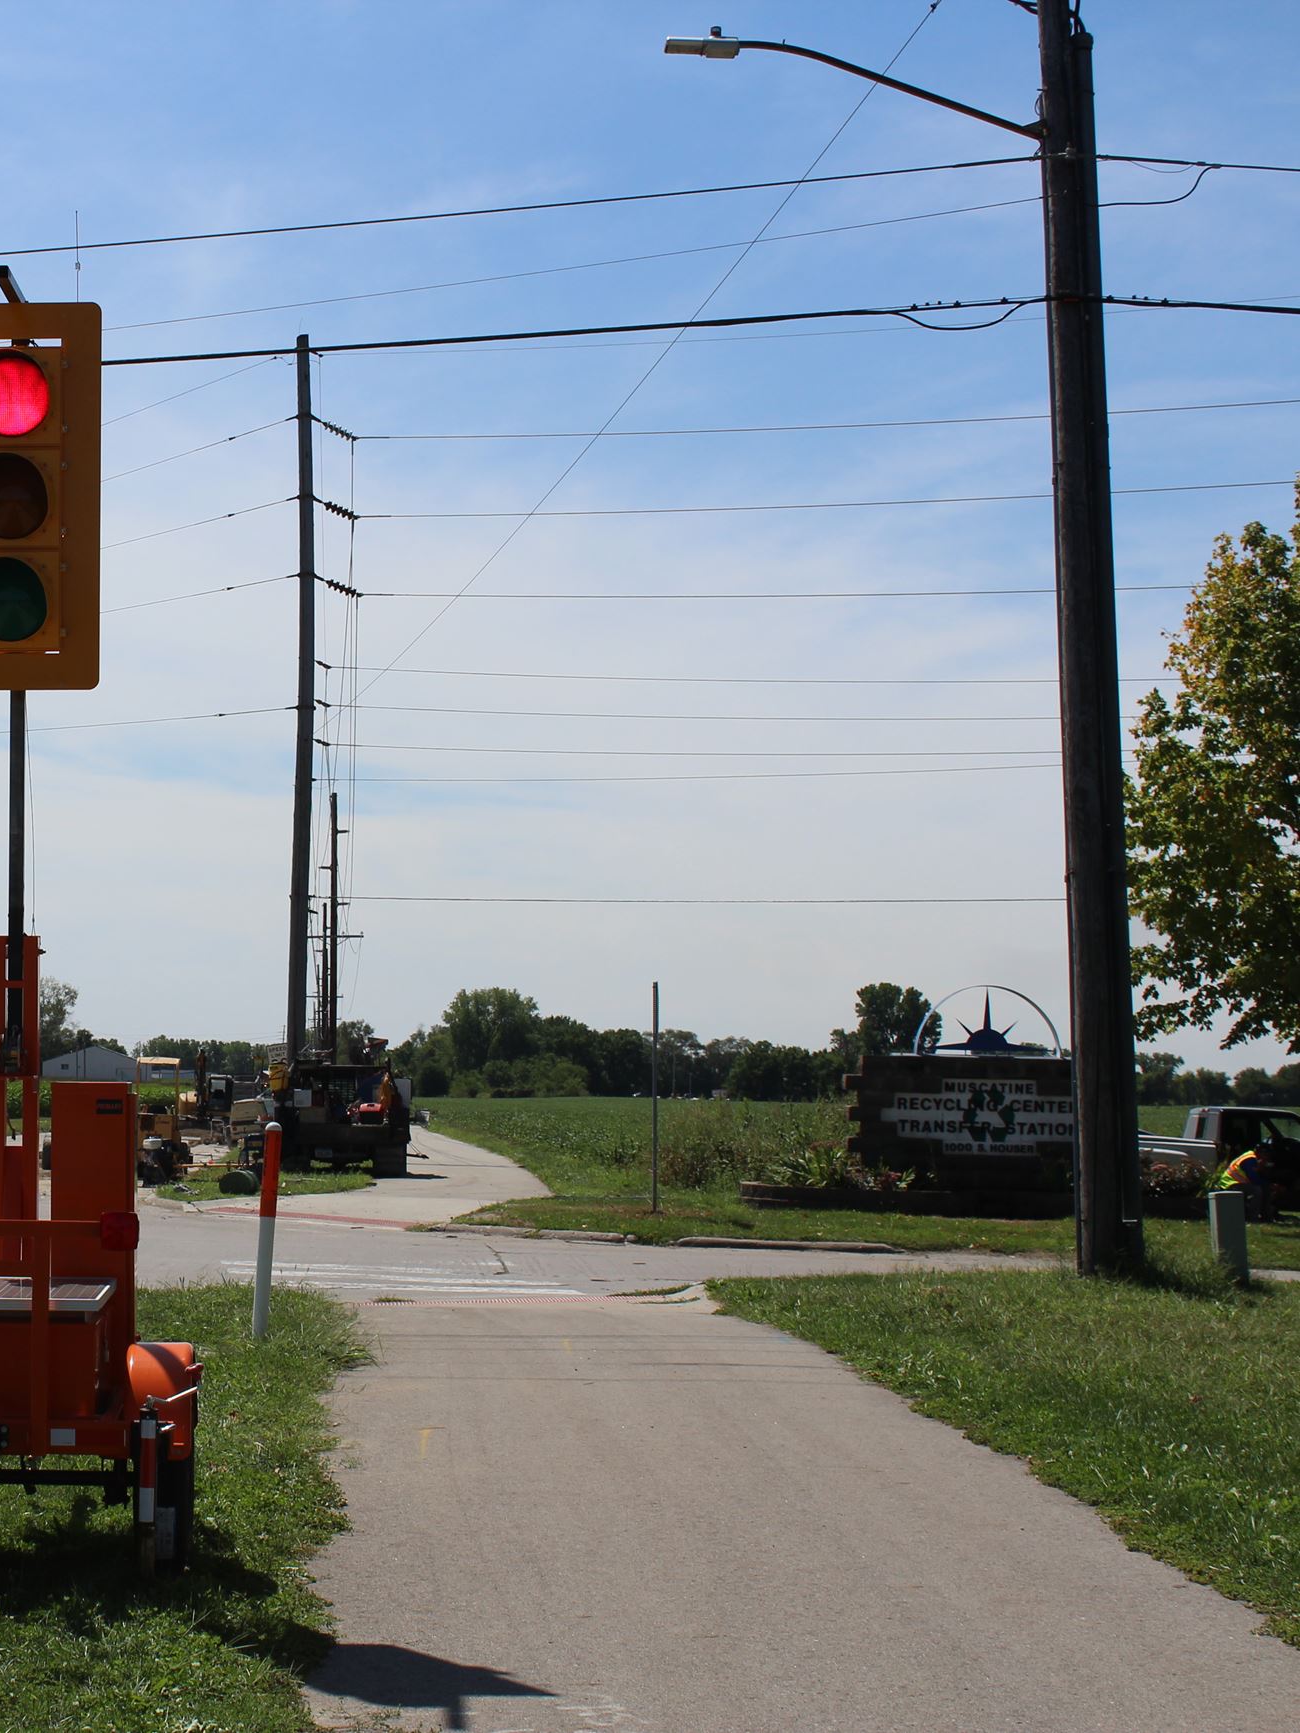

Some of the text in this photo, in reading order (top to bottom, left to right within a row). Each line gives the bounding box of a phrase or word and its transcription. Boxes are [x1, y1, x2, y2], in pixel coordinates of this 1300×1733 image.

[944, 1081, 1034, 1095] MUSCATINE
[1010, 1099, 1073, 1113] CENTE
[1006, 1122, 1073, 1136] STATIO
[944, 1143, 1034, 1153] 1000 S. HOUSER
